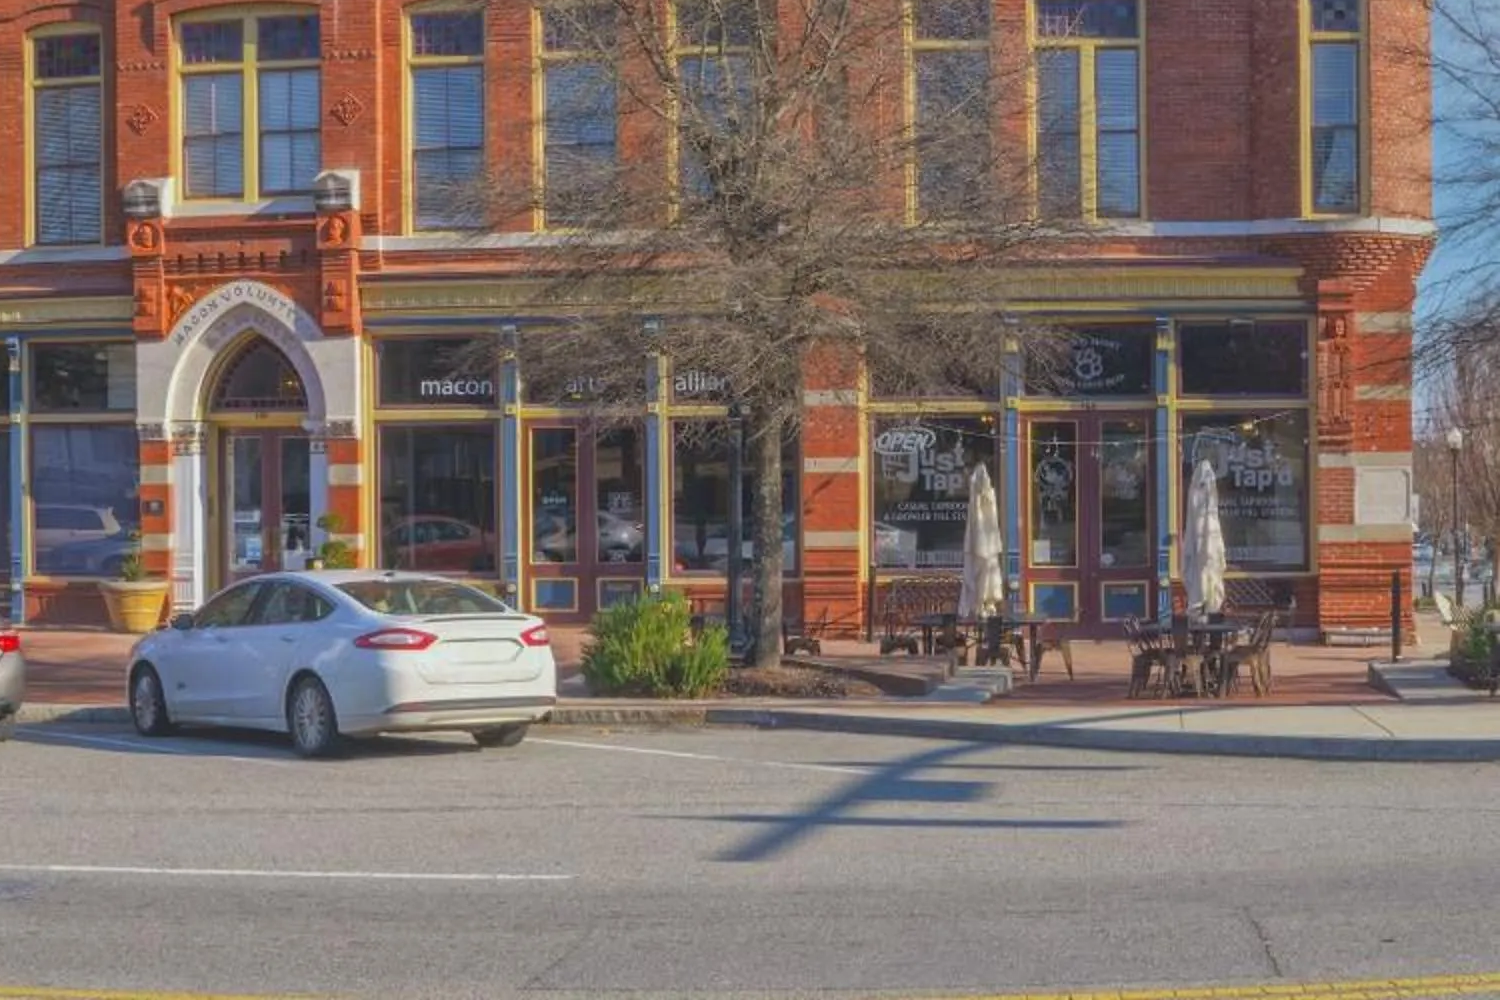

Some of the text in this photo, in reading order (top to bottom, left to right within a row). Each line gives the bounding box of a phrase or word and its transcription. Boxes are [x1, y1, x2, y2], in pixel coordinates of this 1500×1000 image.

[172, 299, 219, 346] MACON
[420, 377, 494, 396] macon
[877, 430, 931, 452] OPEN
